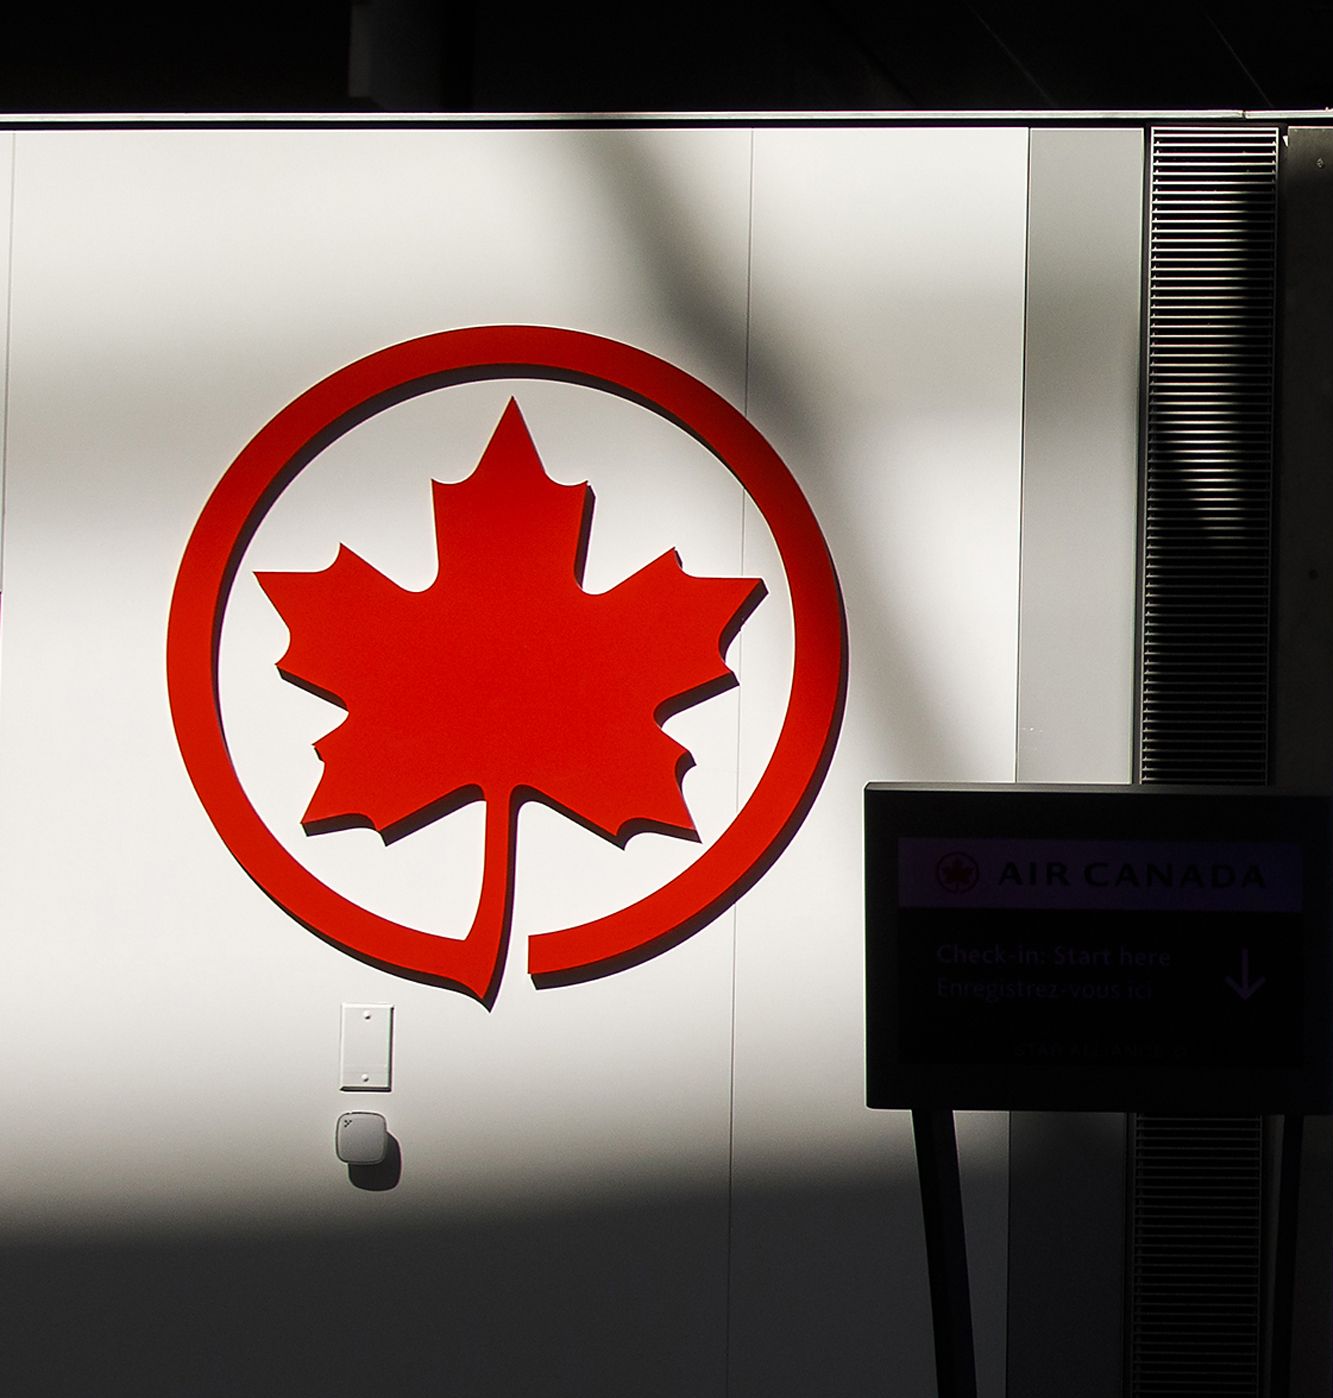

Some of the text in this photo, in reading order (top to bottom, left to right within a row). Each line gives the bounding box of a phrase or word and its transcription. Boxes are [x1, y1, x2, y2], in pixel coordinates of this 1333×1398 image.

[998, 862, 1267, 889] AIR CANADA
[935, 944, 1171, 967] Check-in: Start here
[935, 976, 1153, 1004] Enregistrez-vous ici
